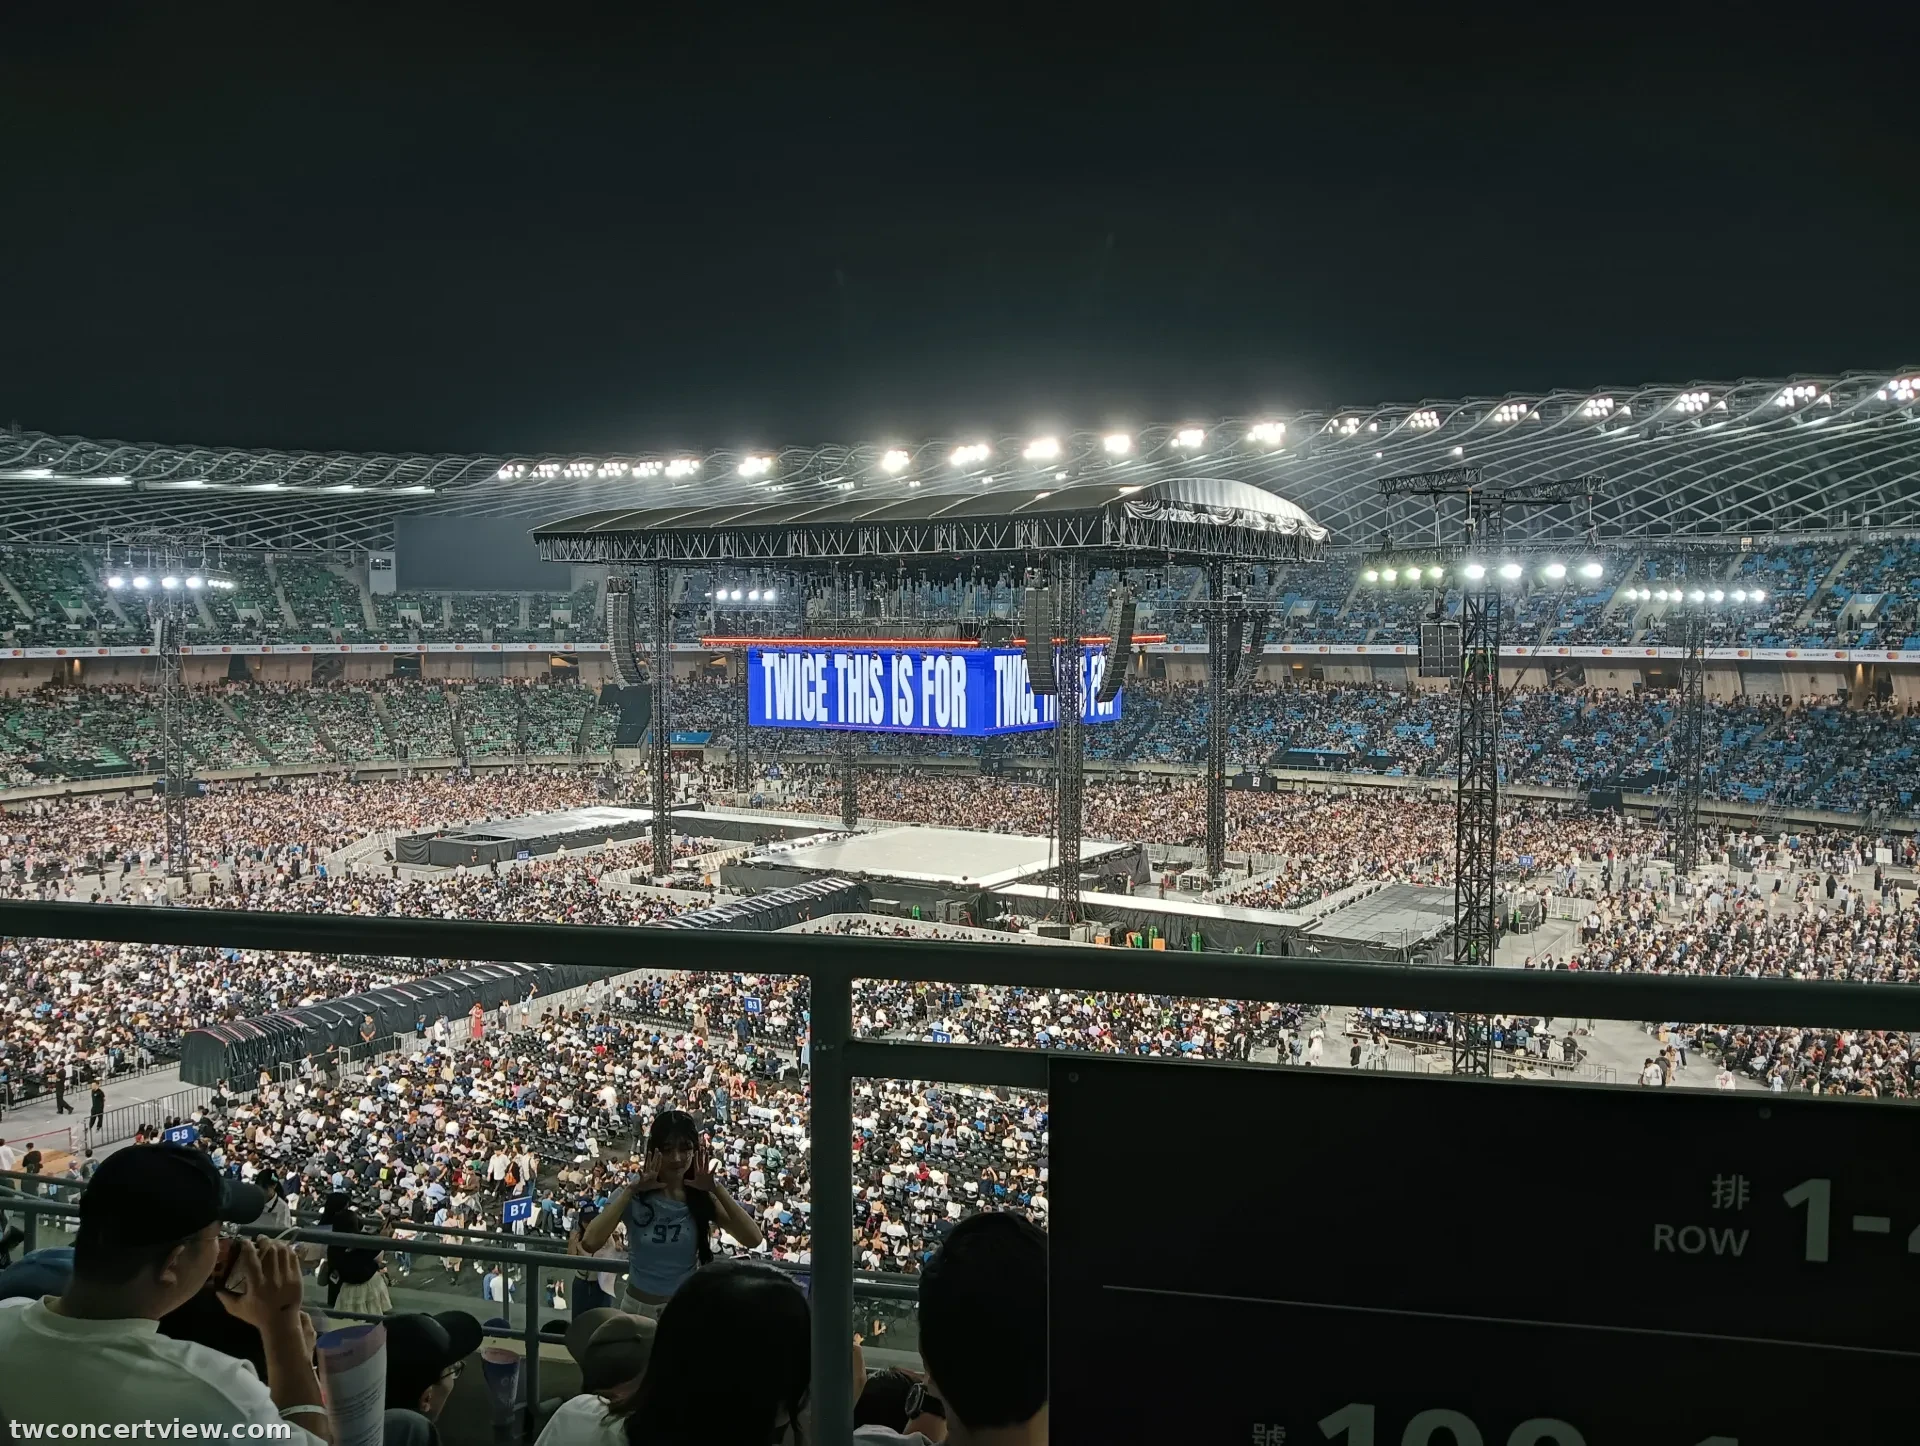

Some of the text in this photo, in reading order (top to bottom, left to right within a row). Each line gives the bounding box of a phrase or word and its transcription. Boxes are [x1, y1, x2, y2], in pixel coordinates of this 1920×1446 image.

[1759, 536, 1780, 544] G25
[762, 653, 828, 721] TWICE
[834, 654, 884, 726] THIS
[892, 654, 914, 727] IS
[921, 655, 967, 728] FOR
[1090, 655, 1113, 717] FO
[747, 1000, 758, 1009] B3
[936, 1034, 947, 1044] B2
[172, 1128, 188, 1142] B8
[1711, 1174, 1750, 1210] 排
[510, 1203, 527, 1217] B7
[651, 1223, 682, 1244] 97
[1654, 1223, 1750, 1256] ROW
